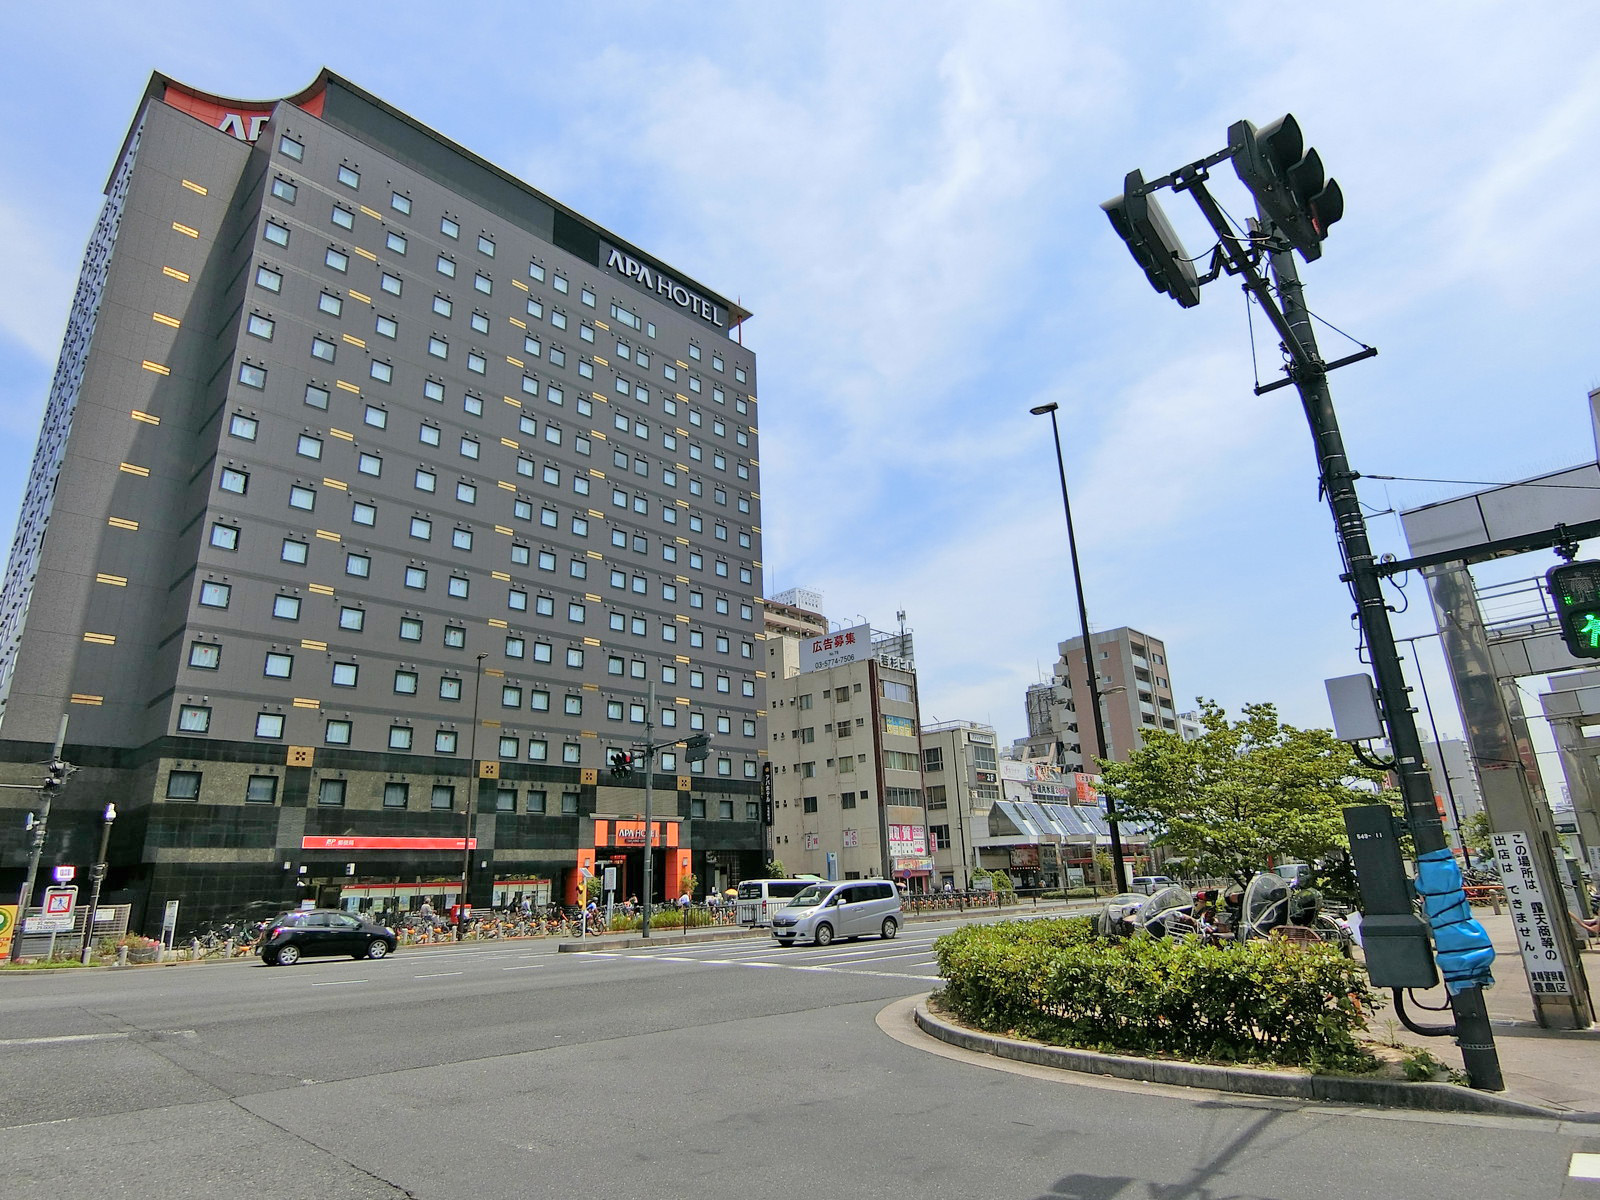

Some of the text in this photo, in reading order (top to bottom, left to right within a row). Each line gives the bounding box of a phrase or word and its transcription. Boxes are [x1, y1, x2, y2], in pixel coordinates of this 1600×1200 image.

[607, 249, 723, 327] APA HOTEL
[812, 632, 856, 653] 広告募集
[815, 654, 855, 669] 03-5774-7506
